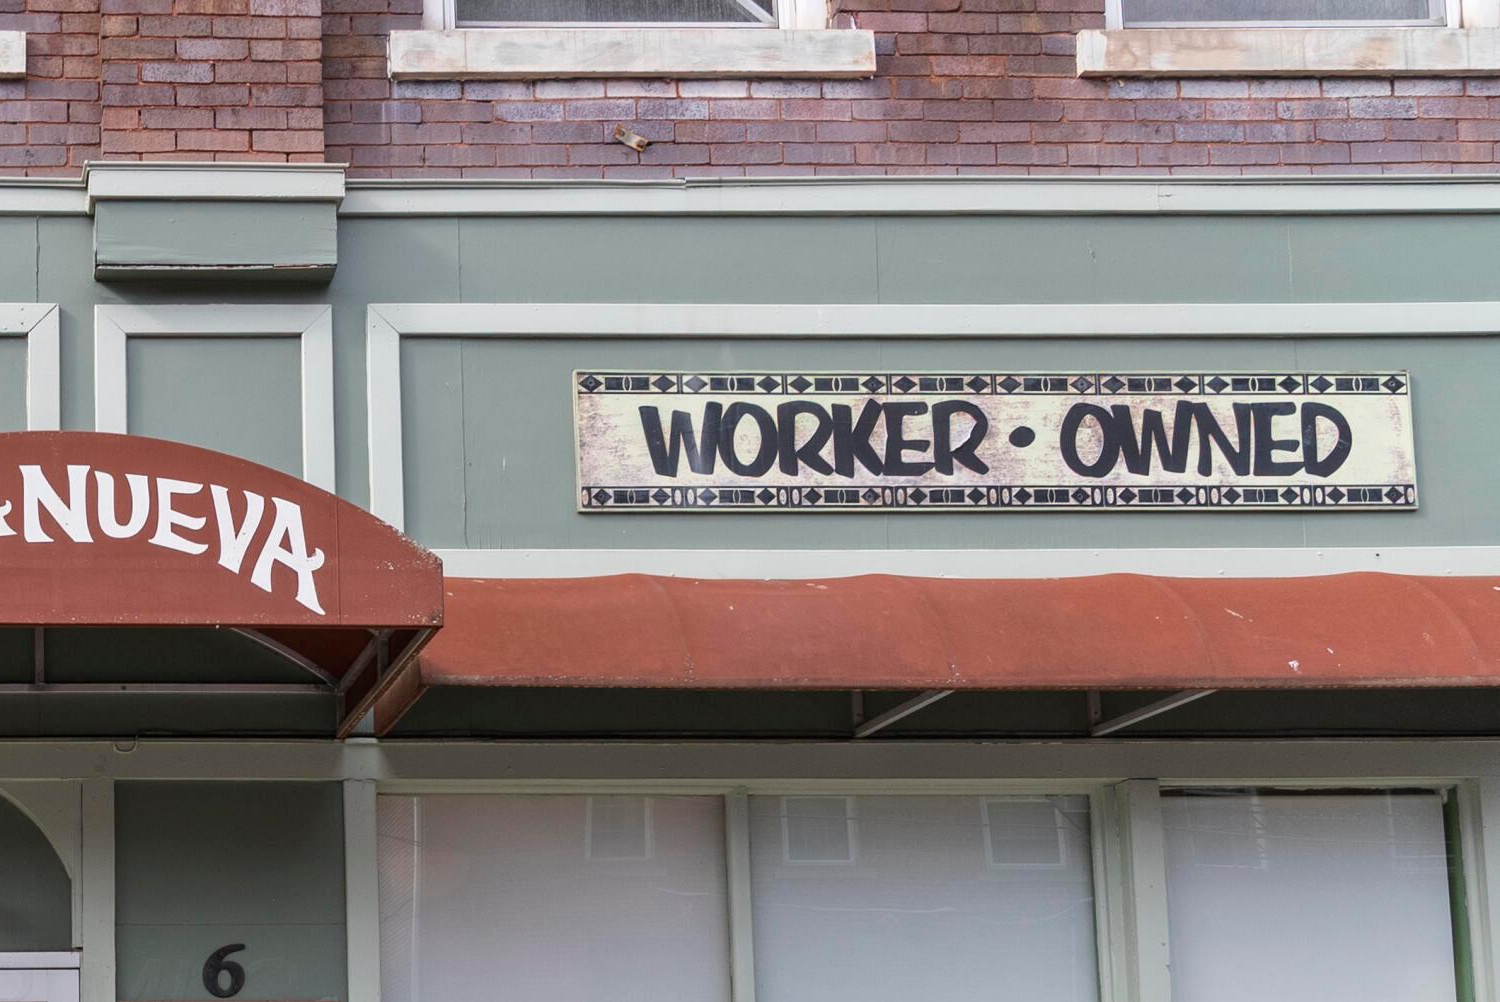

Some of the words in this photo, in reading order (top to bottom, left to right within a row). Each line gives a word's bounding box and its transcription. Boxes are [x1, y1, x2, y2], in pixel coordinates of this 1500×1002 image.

[637, 398, 990, 478] WORKER
[1059, 400, 1353, 478] OWNED
[202, 943, 246, 998] 6
